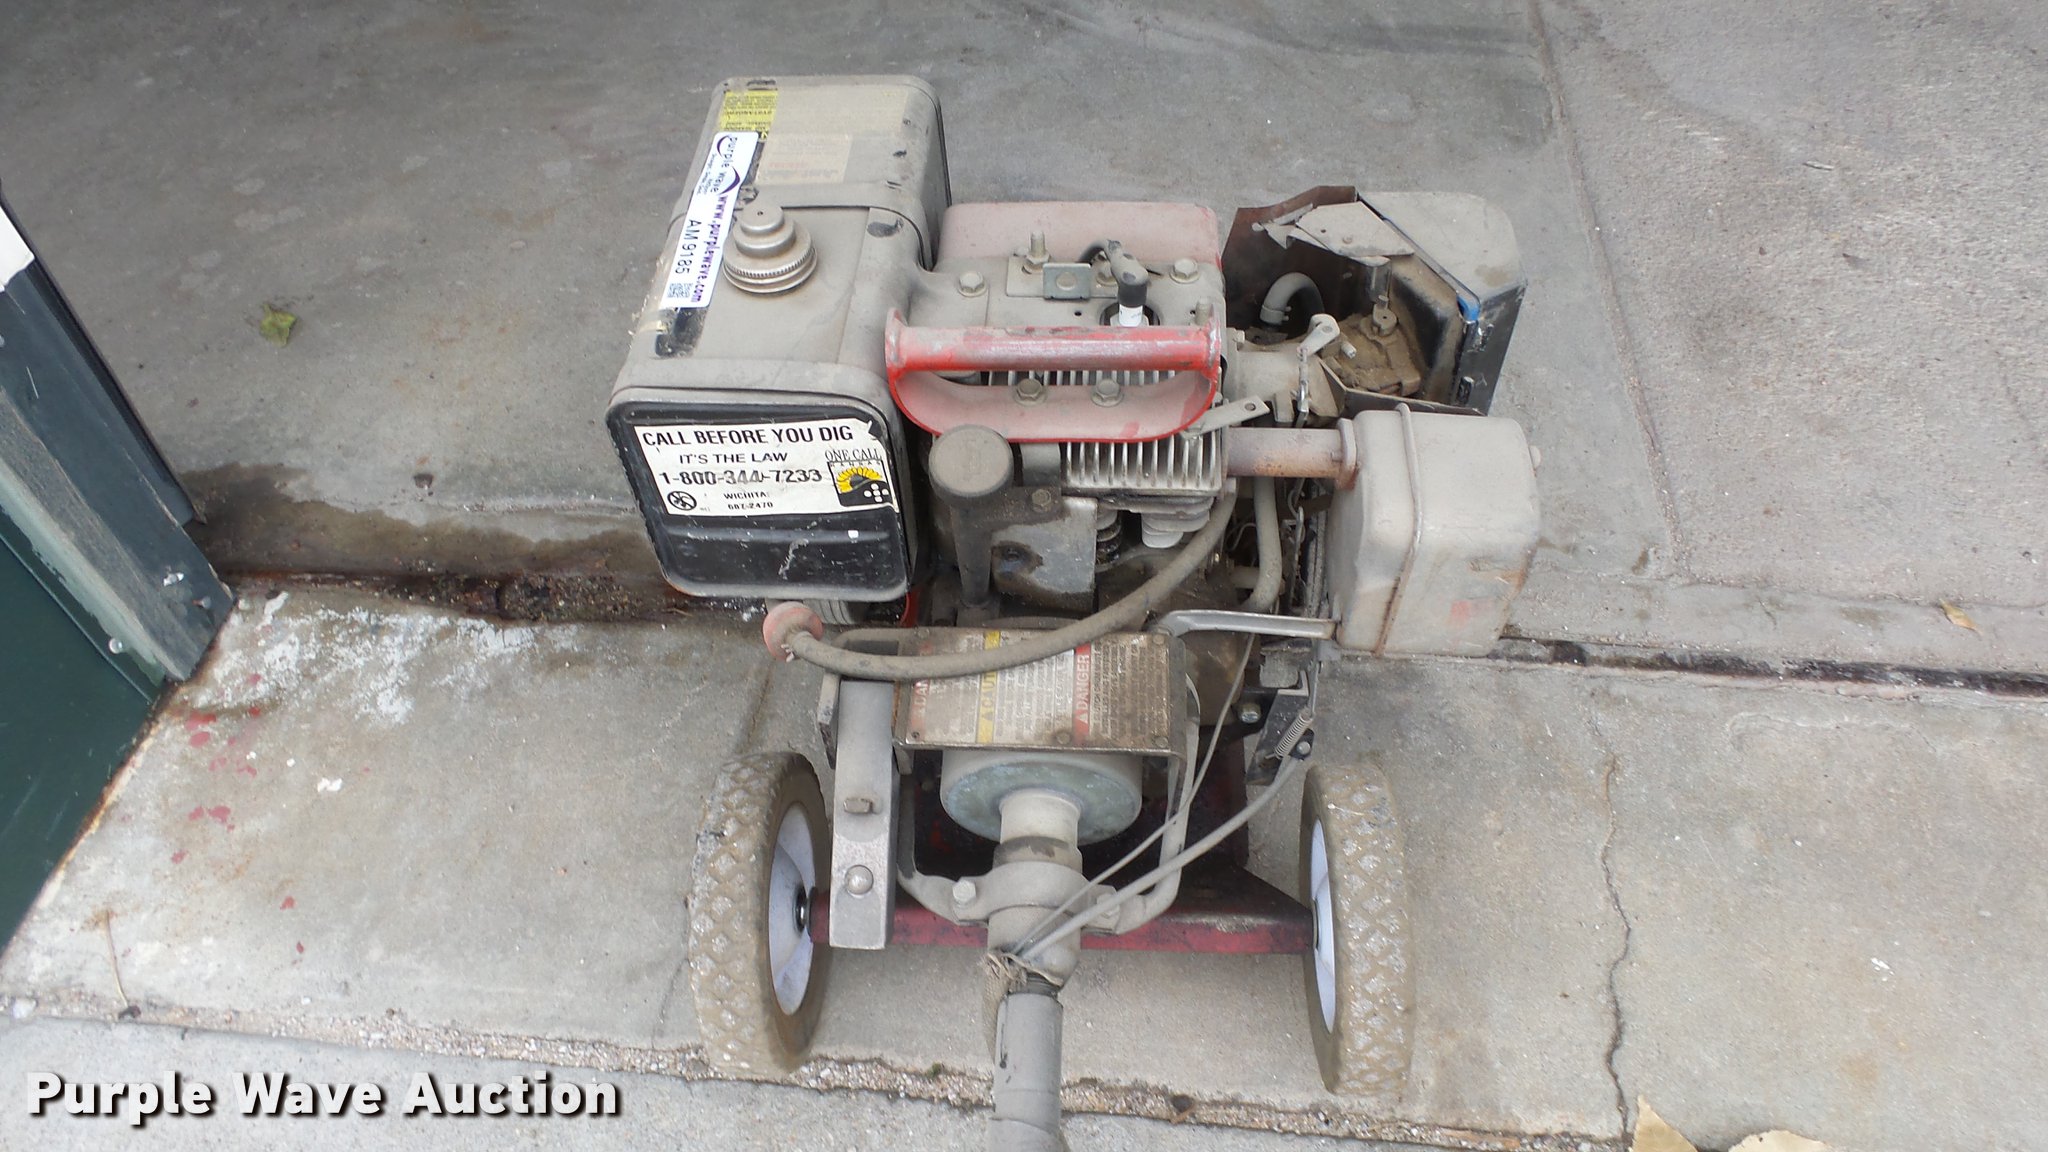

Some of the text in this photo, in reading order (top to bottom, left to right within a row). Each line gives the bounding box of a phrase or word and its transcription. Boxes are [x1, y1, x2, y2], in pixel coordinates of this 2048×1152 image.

[712, 135, 738, 193] purple wave
[691, 196, 728, 302] www.purplewave.com
[643, 425, 854, 447] CALL BEFORE YOU DIG
[679, 452, 788, 464] IT'S THE LAW
[825, 448, 883, 462] ONE CALL
[659, 468, 823, 486] 1-800-344-7233
[1076, 654, 1089, 710] DANGER
